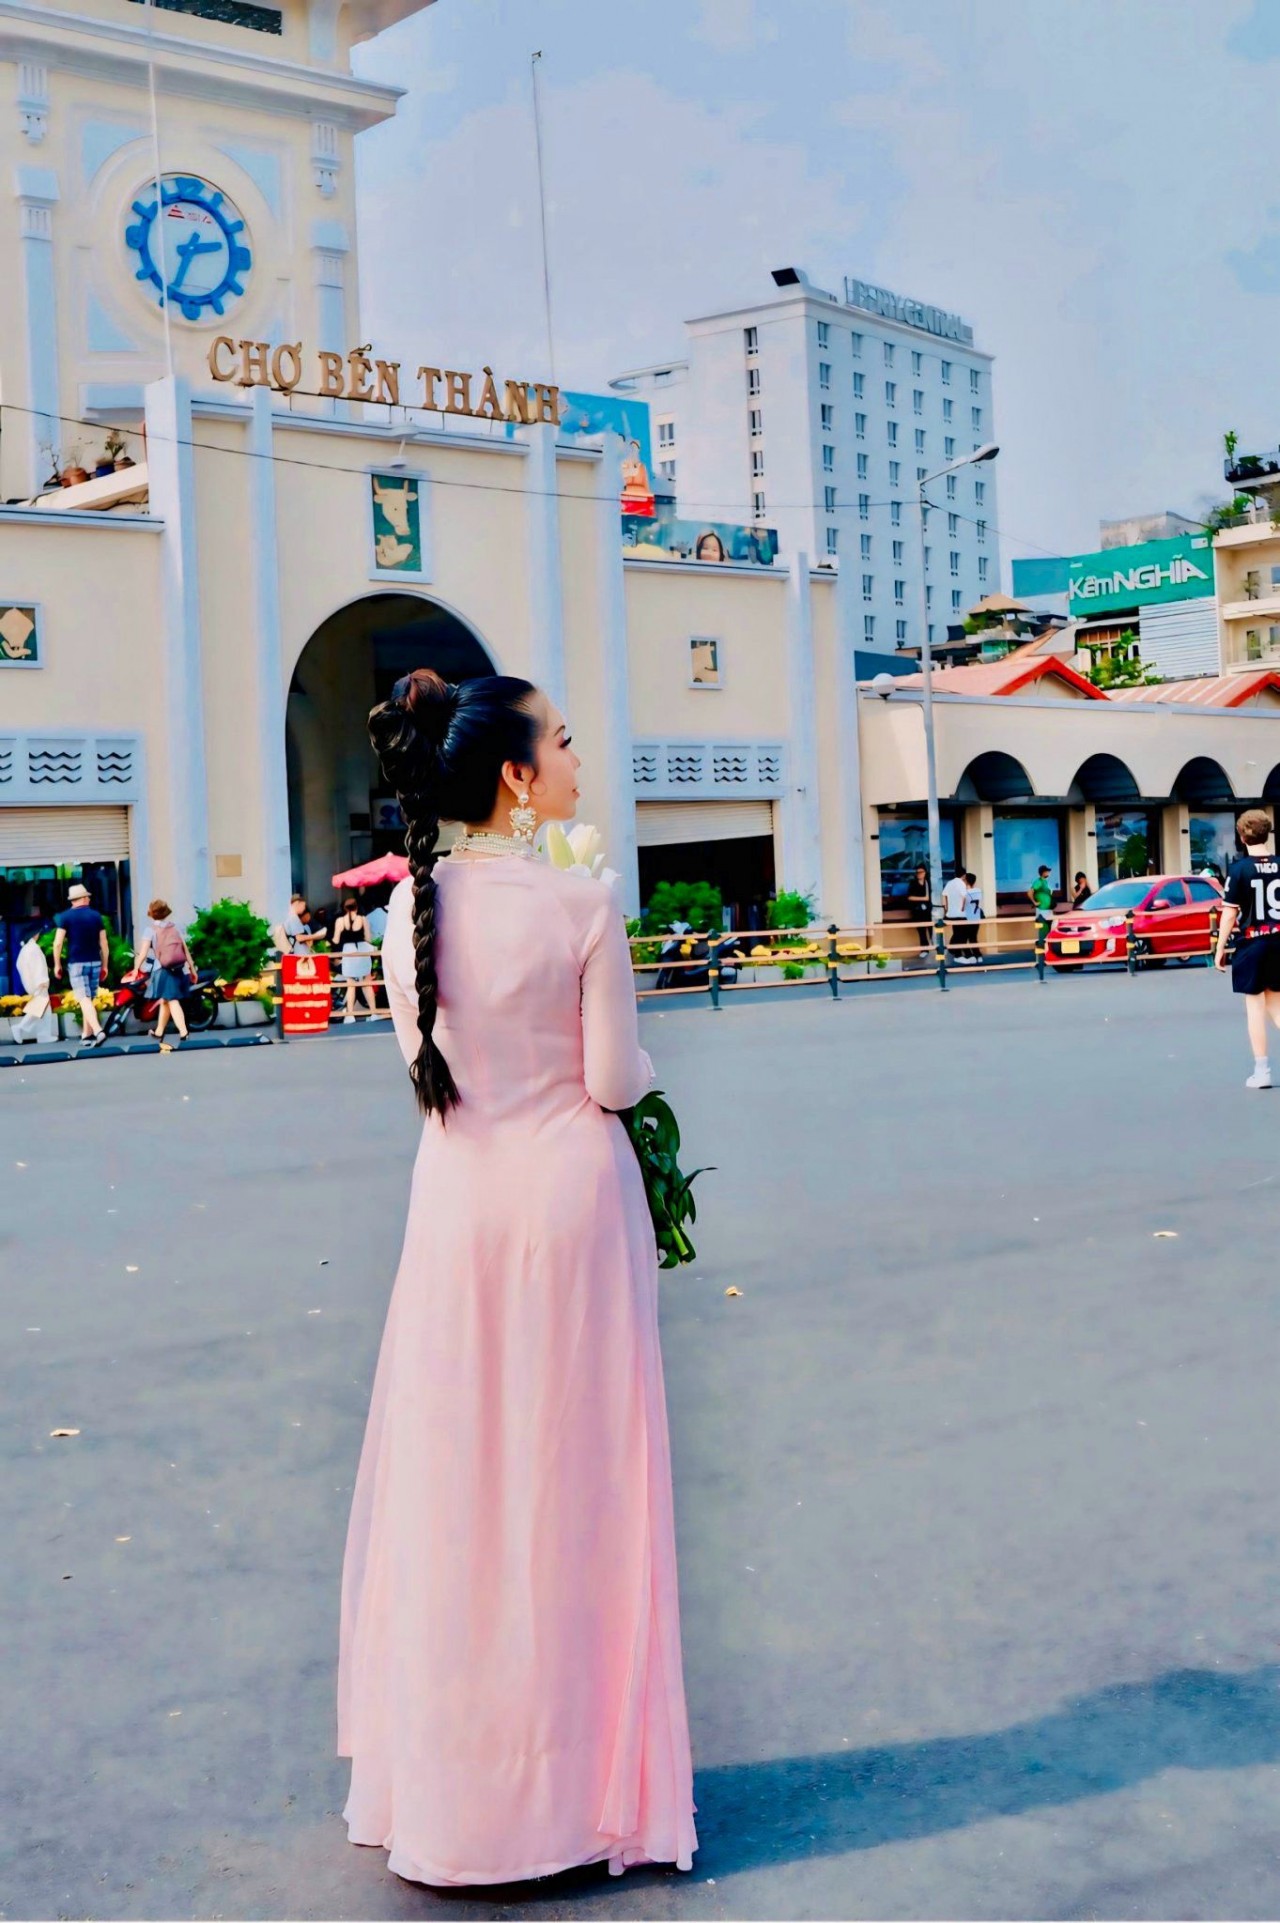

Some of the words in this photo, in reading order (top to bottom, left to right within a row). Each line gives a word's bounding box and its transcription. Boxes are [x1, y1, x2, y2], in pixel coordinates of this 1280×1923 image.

[208, 336, 303, 397] CHỢ
[318, 343, 400, 405] BẾN
[417, 365, 562, 426] THÀNH
[970, 899, 979, 914] 7
[1250, 878, 1280, 920] 19
